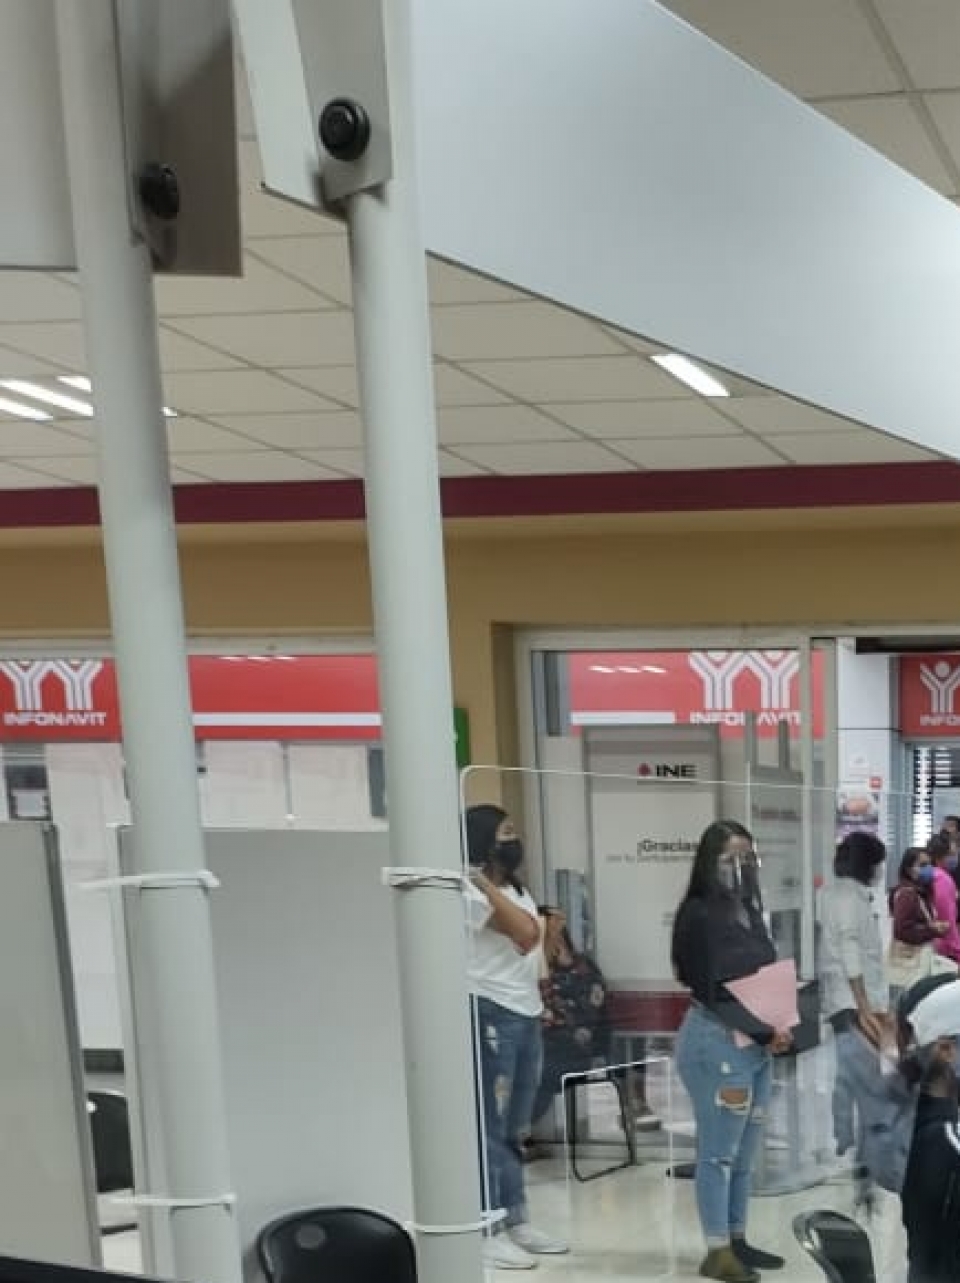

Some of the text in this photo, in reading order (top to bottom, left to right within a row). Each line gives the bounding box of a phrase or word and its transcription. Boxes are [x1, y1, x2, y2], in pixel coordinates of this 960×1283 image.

[4, 711, 107, 726] INFONAVIT
[689, 711, 802, 726] INFOAVIT
[655, 764, 697, 778] INE
